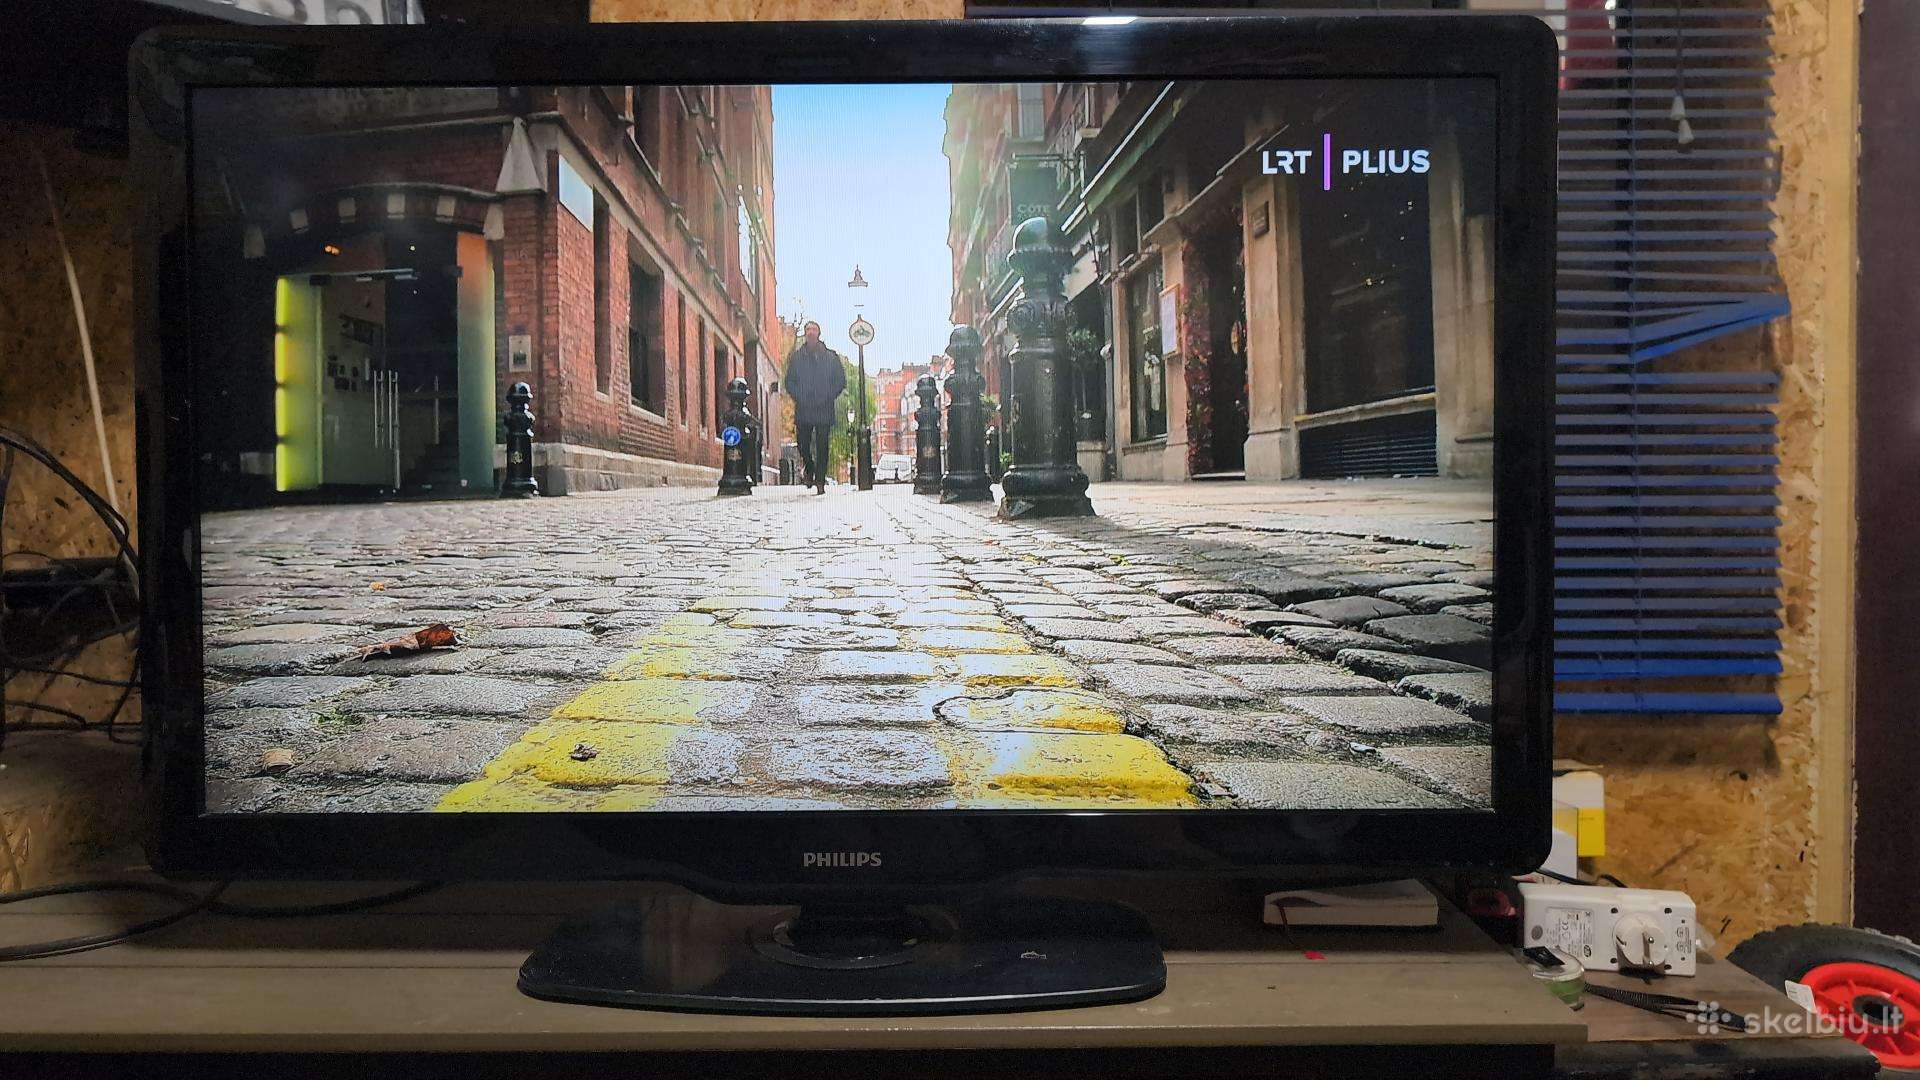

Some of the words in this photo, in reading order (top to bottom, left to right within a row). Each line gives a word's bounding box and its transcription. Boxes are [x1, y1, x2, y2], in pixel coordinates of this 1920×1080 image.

[1262, 150, 1313, 175] LRT
[1342, 149, 1431, 174] PLIUS
[803, 852, 882, 867] PHILIPS
